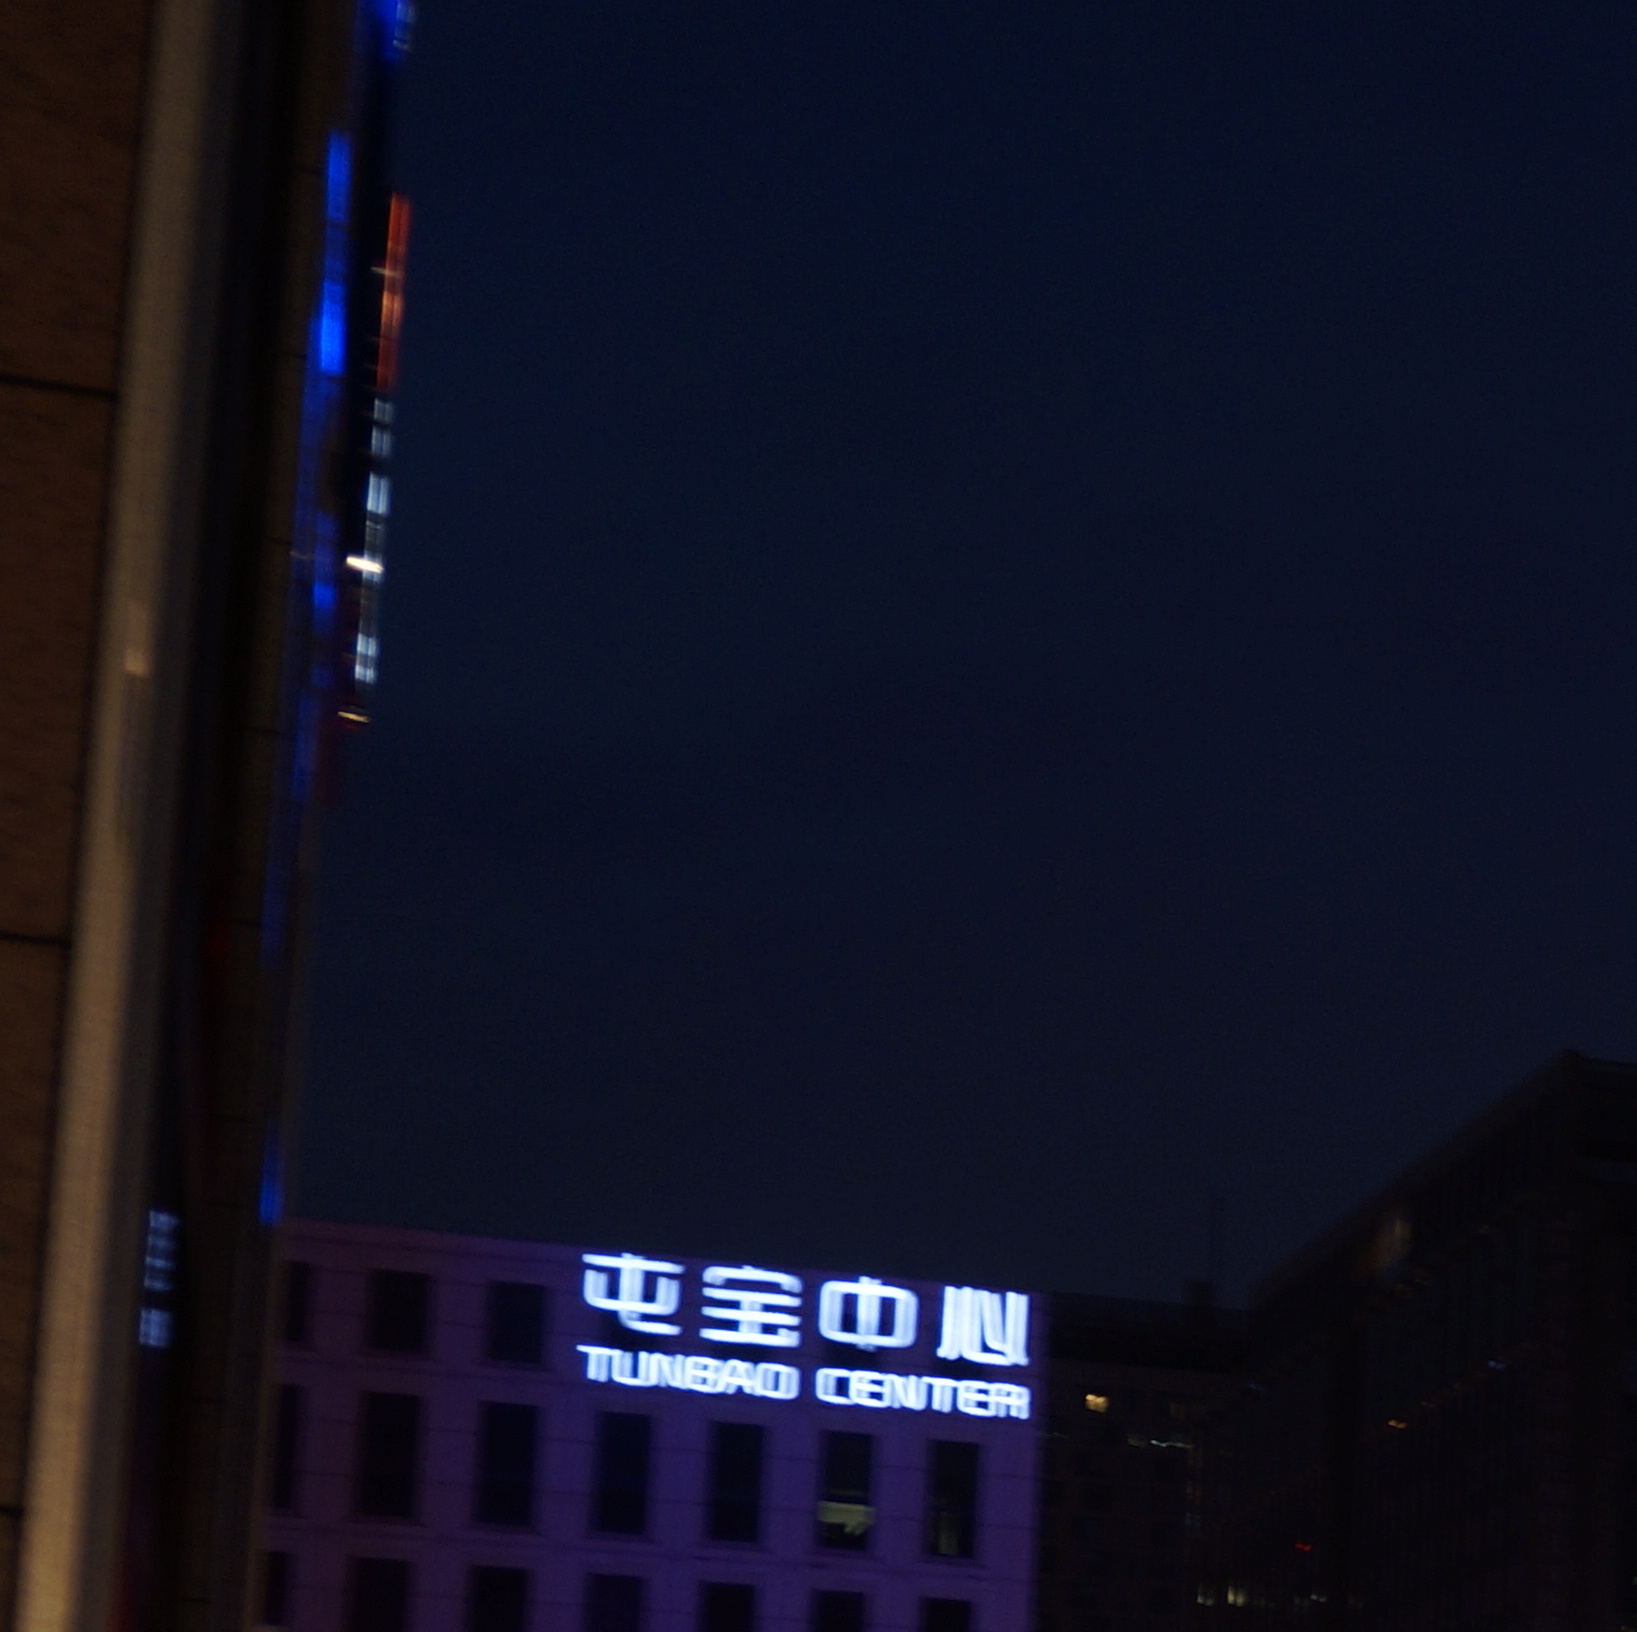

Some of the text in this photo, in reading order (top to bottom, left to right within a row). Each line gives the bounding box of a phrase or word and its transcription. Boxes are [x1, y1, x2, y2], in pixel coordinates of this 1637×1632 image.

[582, 1252, 1031, 1367] 屯宝中心
[576, 1344, 1031, 1420] TUNBAO CENTER
